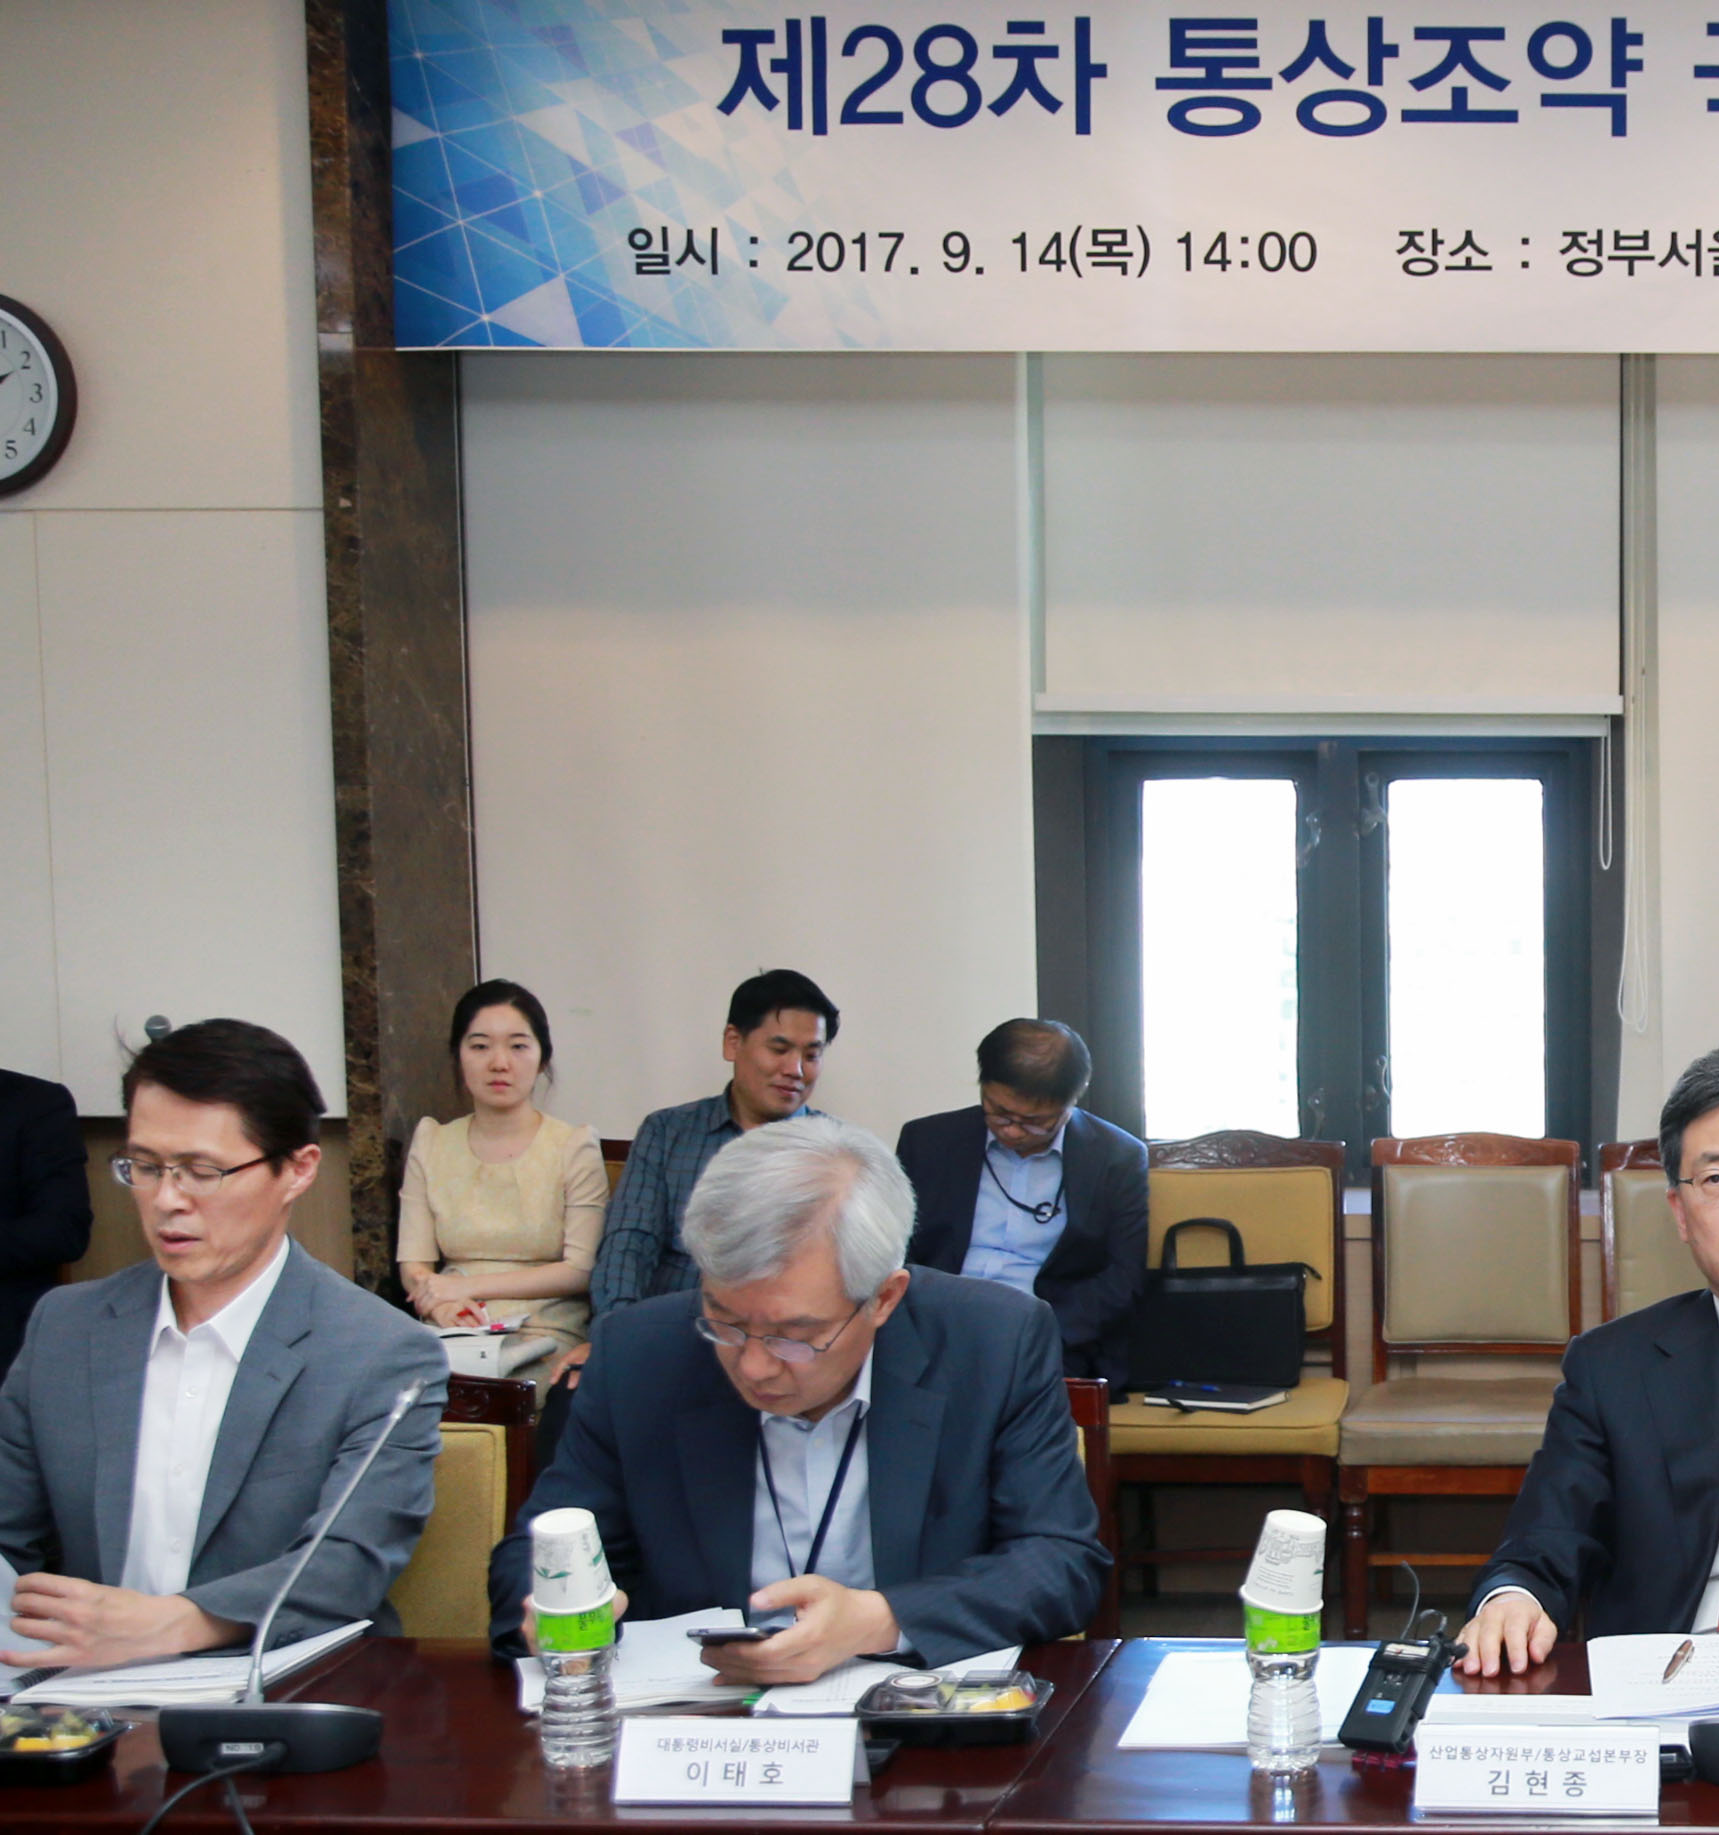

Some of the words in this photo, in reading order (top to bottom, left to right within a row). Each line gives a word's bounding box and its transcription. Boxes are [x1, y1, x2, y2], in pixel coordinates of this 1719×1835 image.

[716, 15, 1108, 136] 제28차
[1155, 16, 1644, 137] 통상조약
[627, 226, 719, 276] 일시
[786, 231, 919, 275] 2017.
[942, 231, 984, 275] 9.
[1012, 225, 1150, 278] 14(목)
[1177, 231, 1317, 273] 14:00
[1396, 228, 1493, 277] 장소
[21, 351, 31, 369] 2
[29, 383, 43, 403] 3
[23, 418, 36, 436] 4
[4, 440, 18, 459] 5
